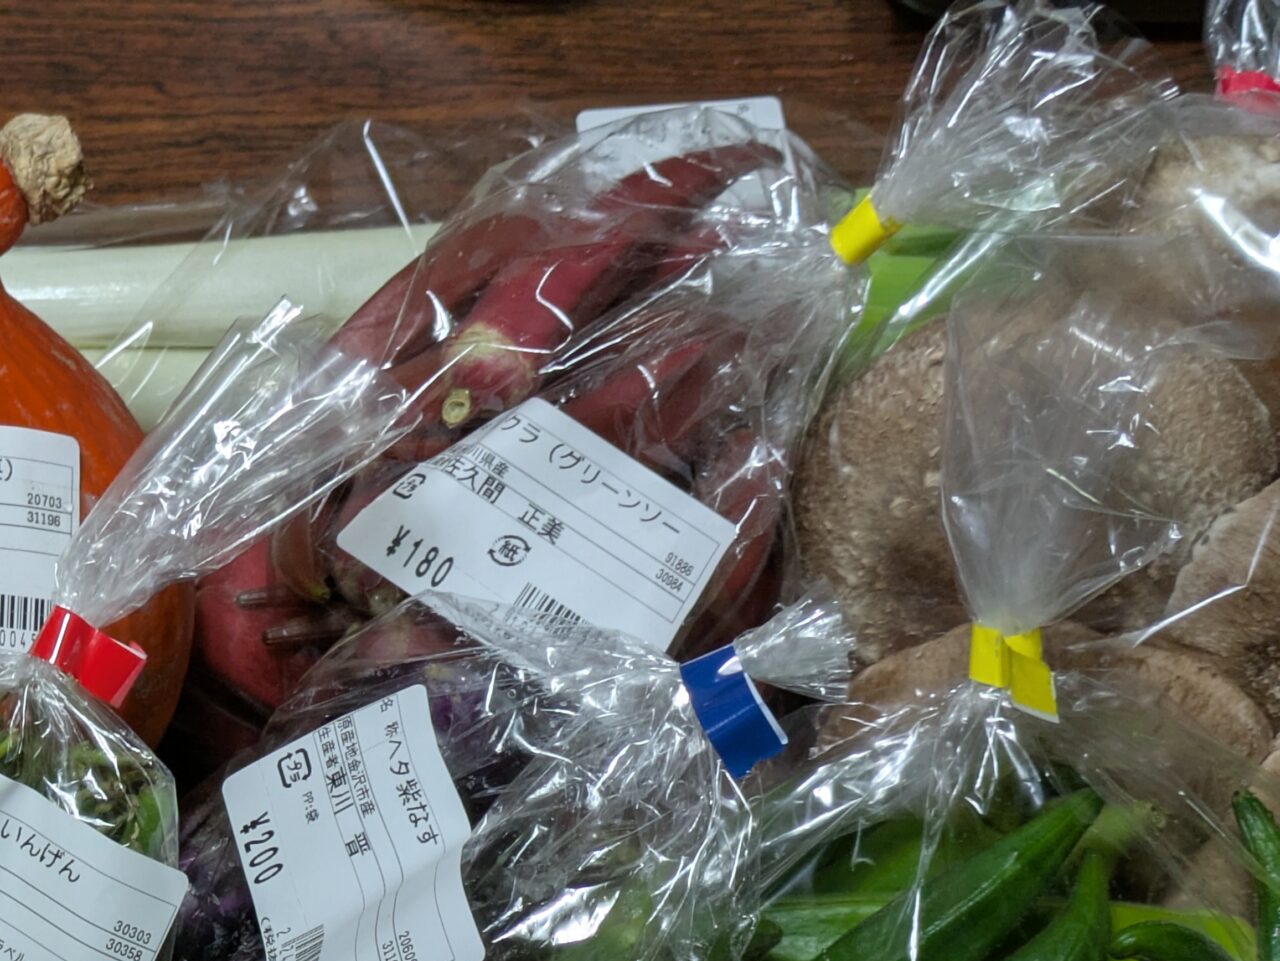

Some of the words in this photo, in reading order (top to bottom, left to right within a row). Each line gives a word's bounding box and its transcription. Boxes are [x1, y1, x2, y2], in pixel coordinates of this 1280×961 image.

[27, 493, 63, 509] 20703
[27, 511, 61, 528] 31196
[516, 502, 566, 545] 正美
[385, 524, 455, 587] ¥180
[663, 551, 694, 577] 91886
[655, 568, 683, 592] 30984
[326, 769, 351, 816] 東川
[344, 832, 370, 857] 晋
[238, 810, 284, 884] ¥200
[113, 919, 152, 945] 30303
